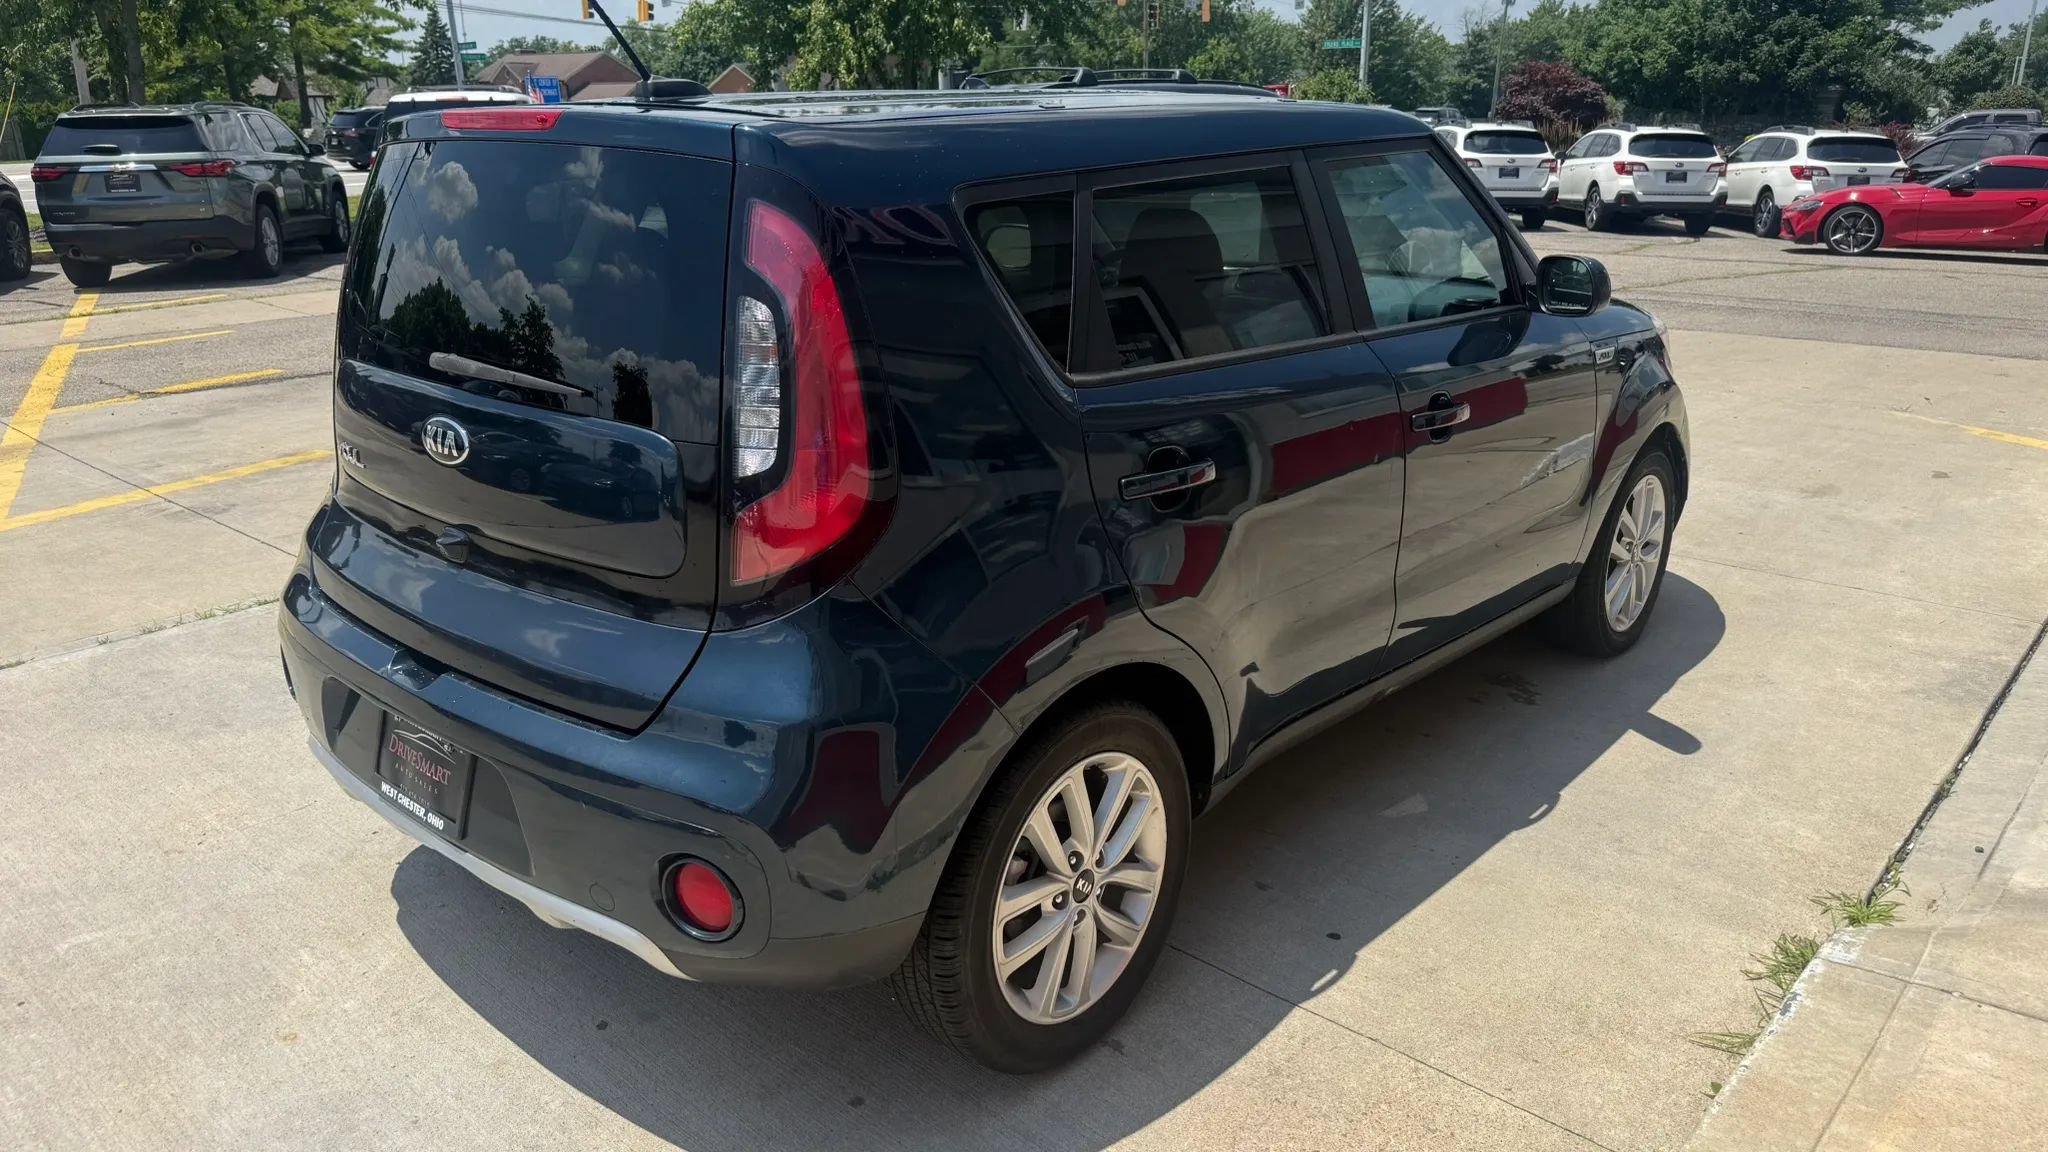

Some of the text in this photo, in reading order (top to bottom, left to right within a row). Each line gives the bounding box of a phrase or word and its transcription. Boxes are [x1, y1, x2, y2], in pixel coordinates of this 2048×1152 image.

[426, 424, 458, 457] KIA
[381, 780, 444, 830] WEST CHESTER, OHIO
[1077, 879, 1091, 894] KIA
